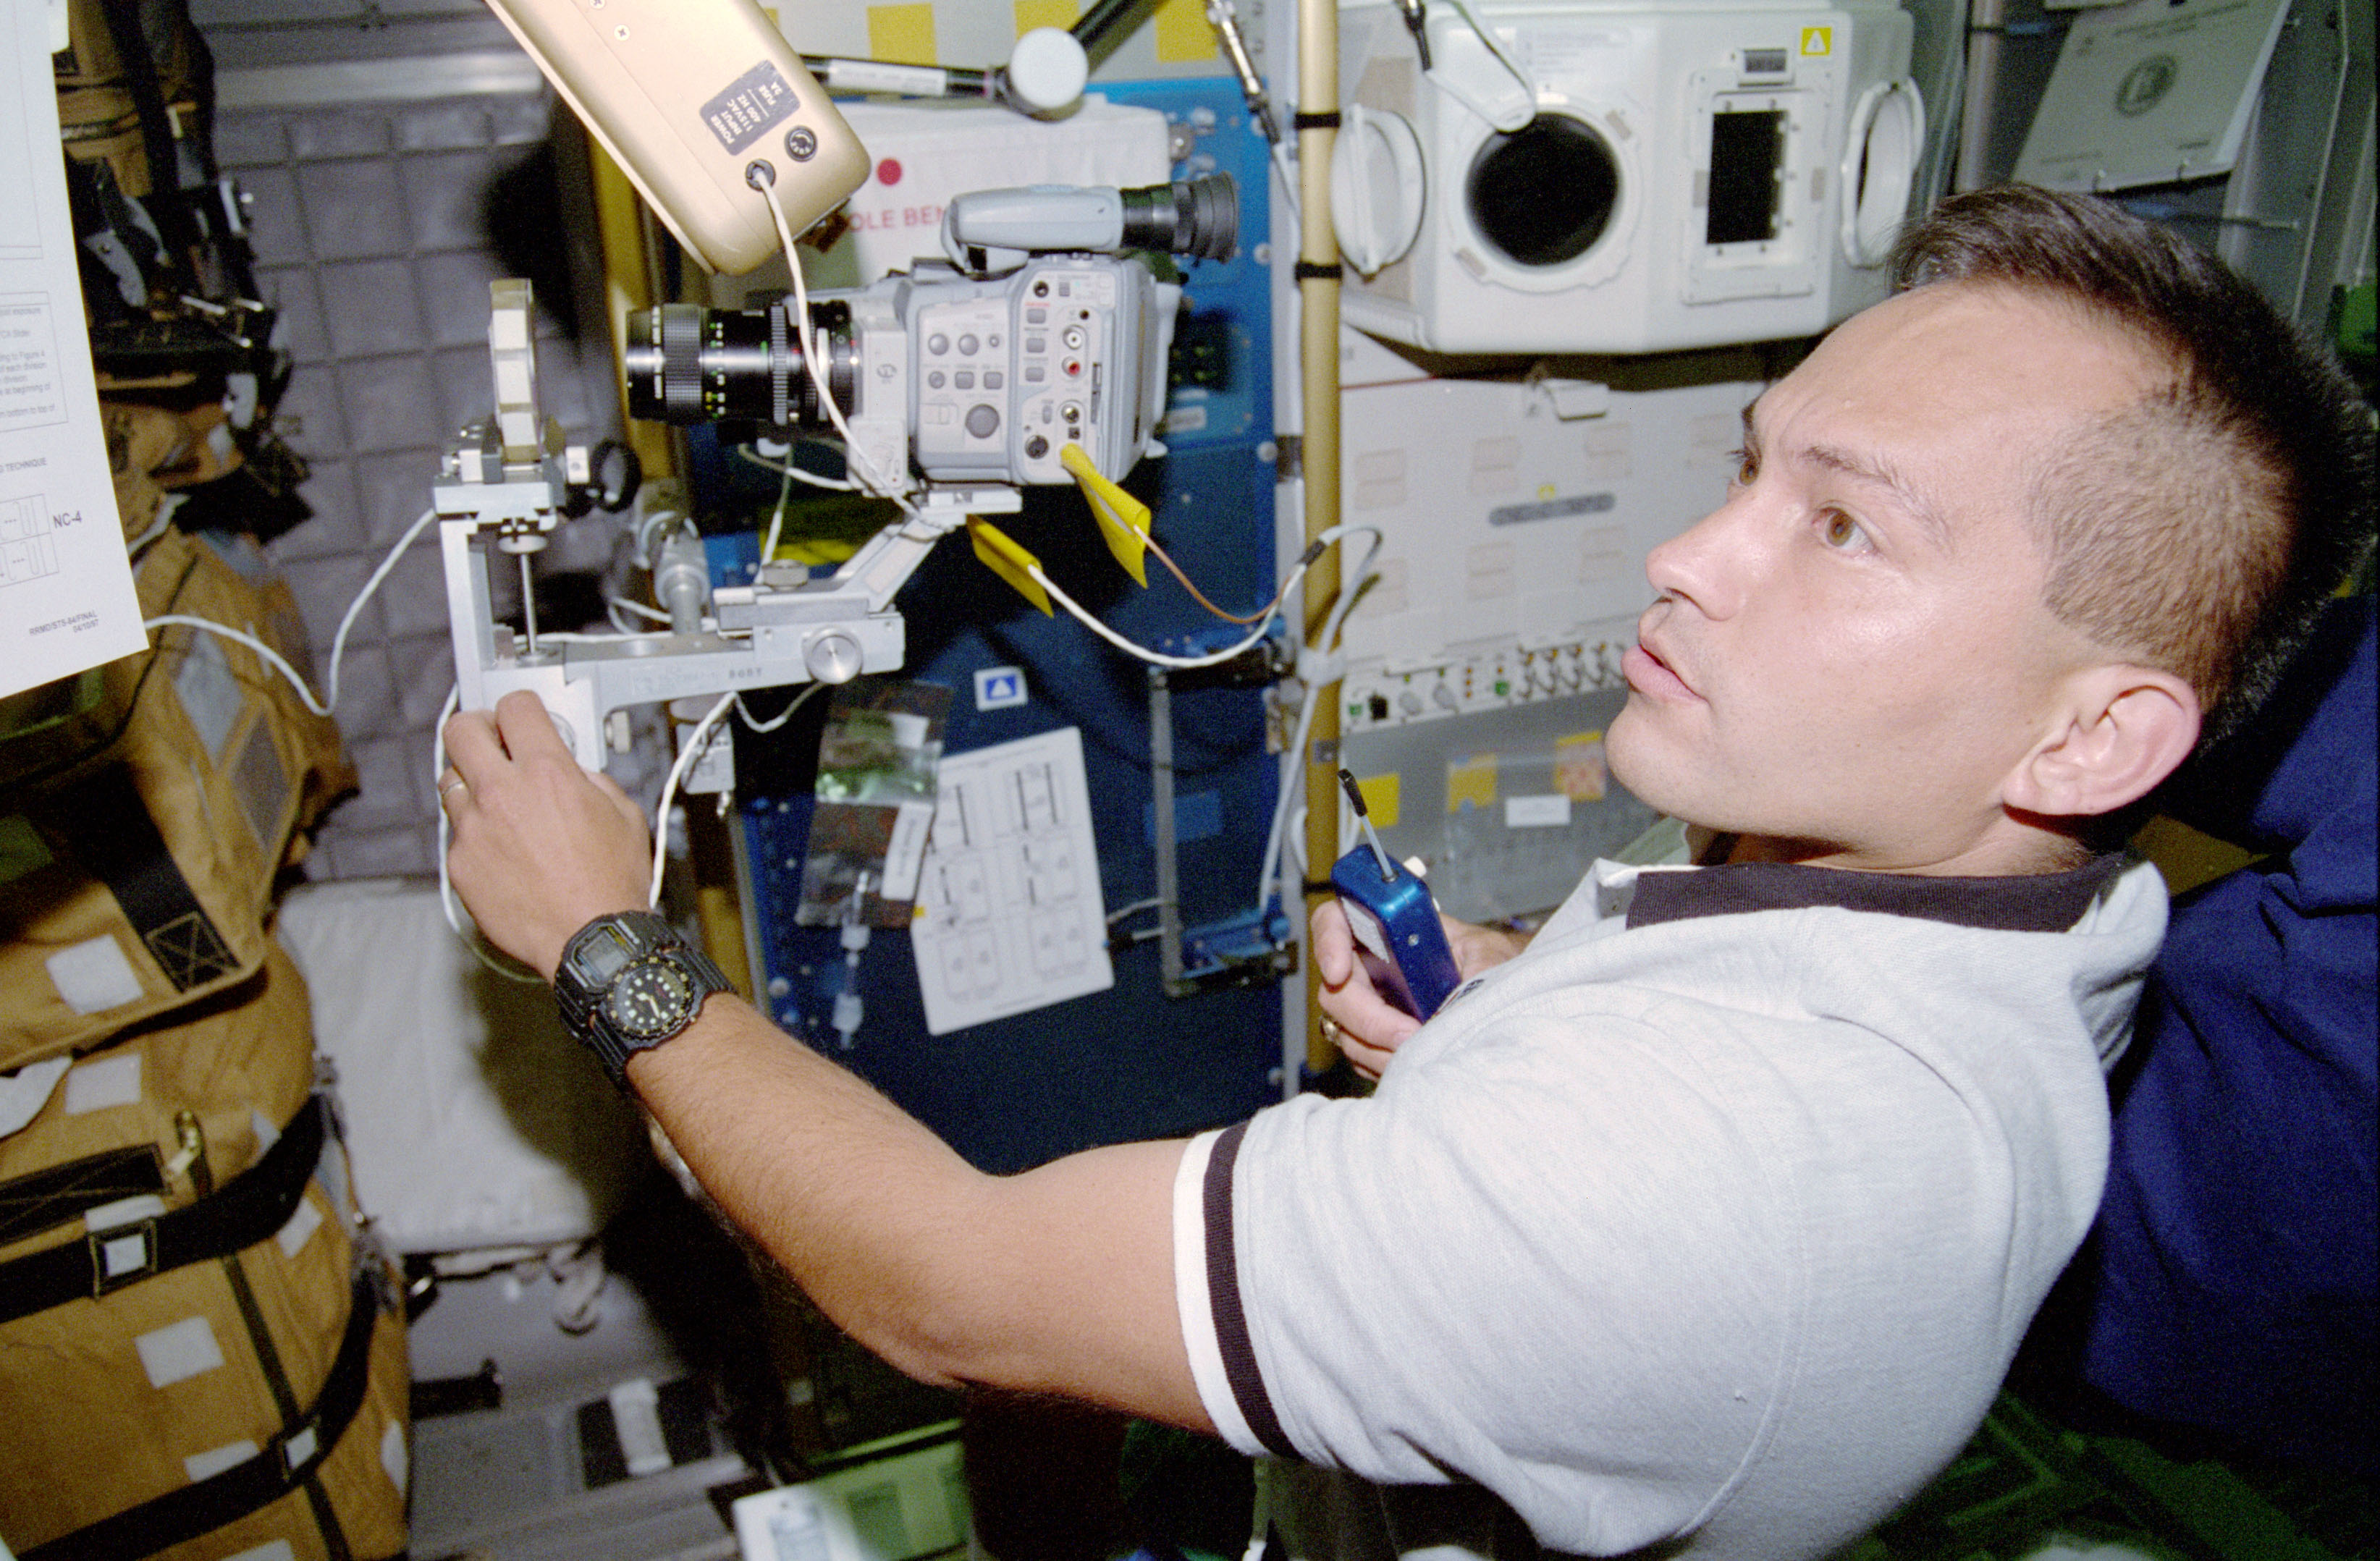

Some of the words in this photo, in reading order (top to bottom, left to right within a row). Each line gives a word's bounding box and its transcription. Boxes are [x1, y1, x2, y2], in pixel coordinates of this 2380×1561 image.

[737, 93, 750, 108] HZ
[759, 84, 777, 106] FUSE
[720, 111, 743, 135] INPUT
[727, 98, 754, 132] 115VAC
[746, 106, 761, 122] 400
[711, 114, 735, 144] POWER
[5, 457, 47, 472] TECHNIQUE
[53, 510, 83, 528] NC-4
